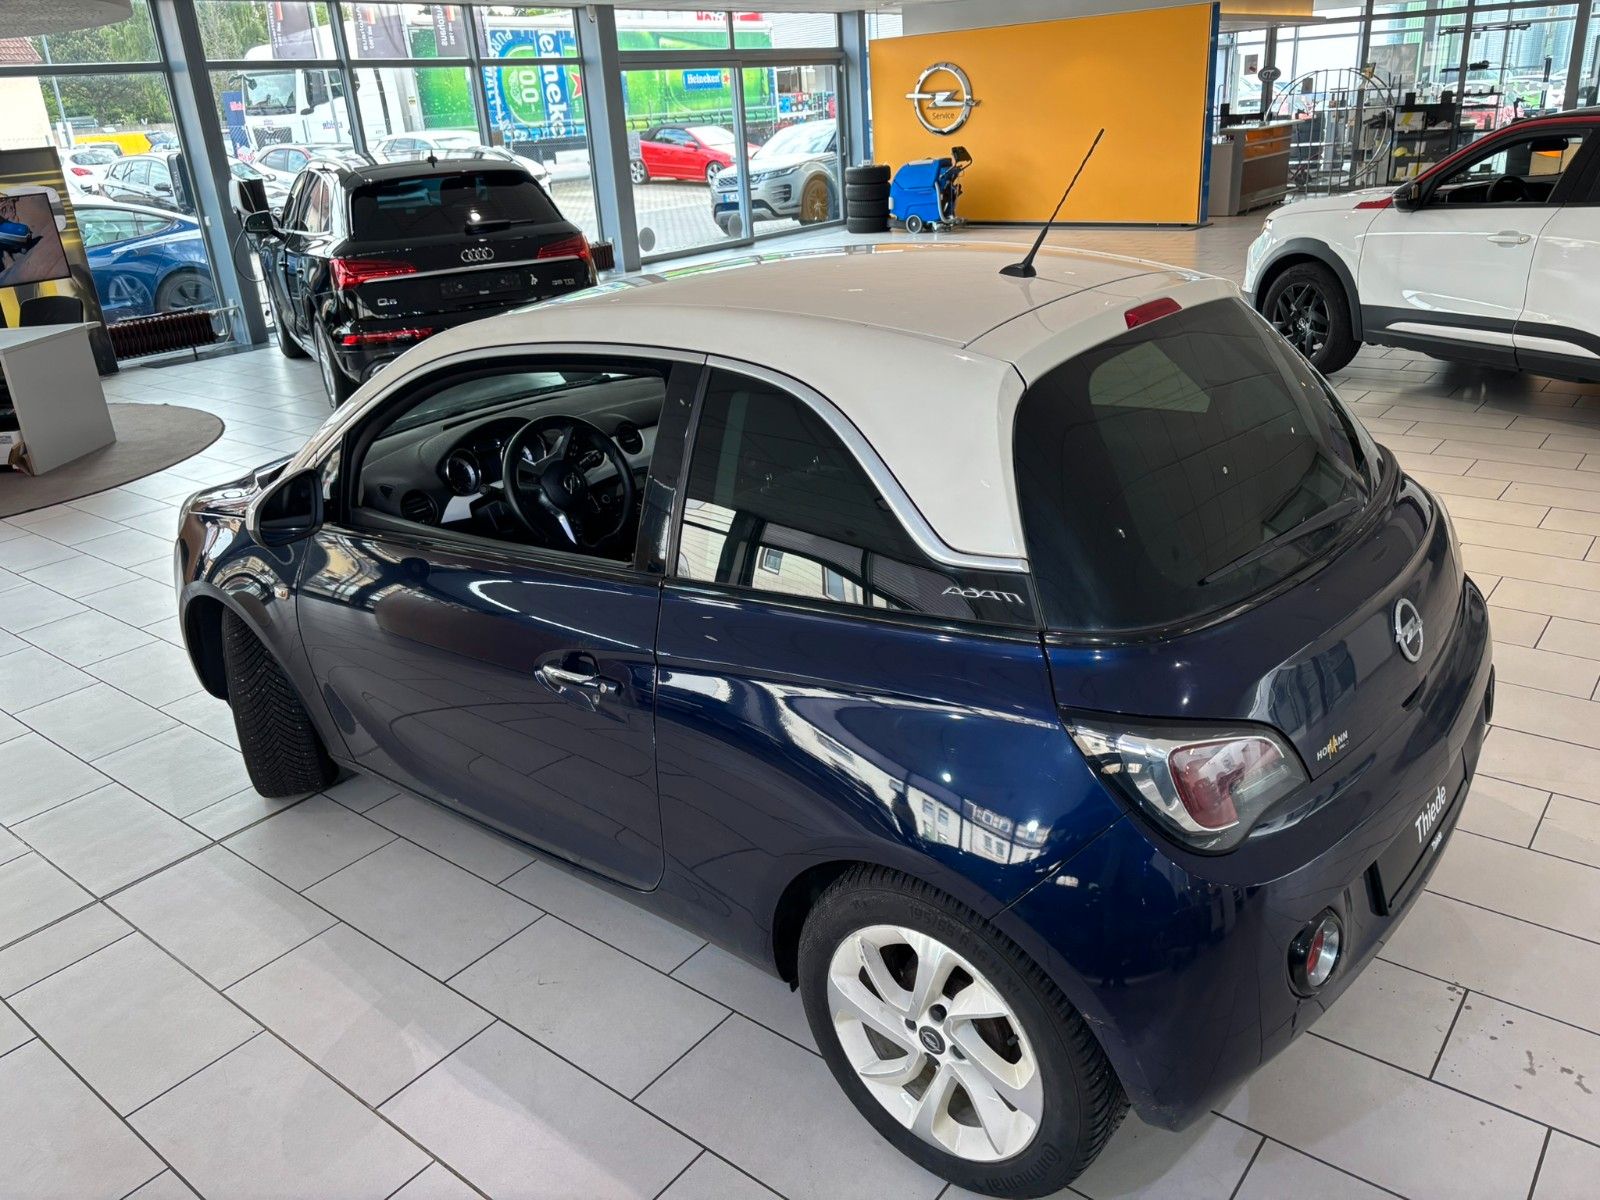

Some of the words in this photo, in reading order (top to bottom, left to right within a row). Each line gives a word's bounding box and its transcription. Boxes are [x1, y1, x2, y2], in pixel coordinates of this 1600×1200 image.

[687, 73, 720, 84] Heineken
[932, 112, 955, 120] Service
[1414, 785, 1447, 843] Thiede
